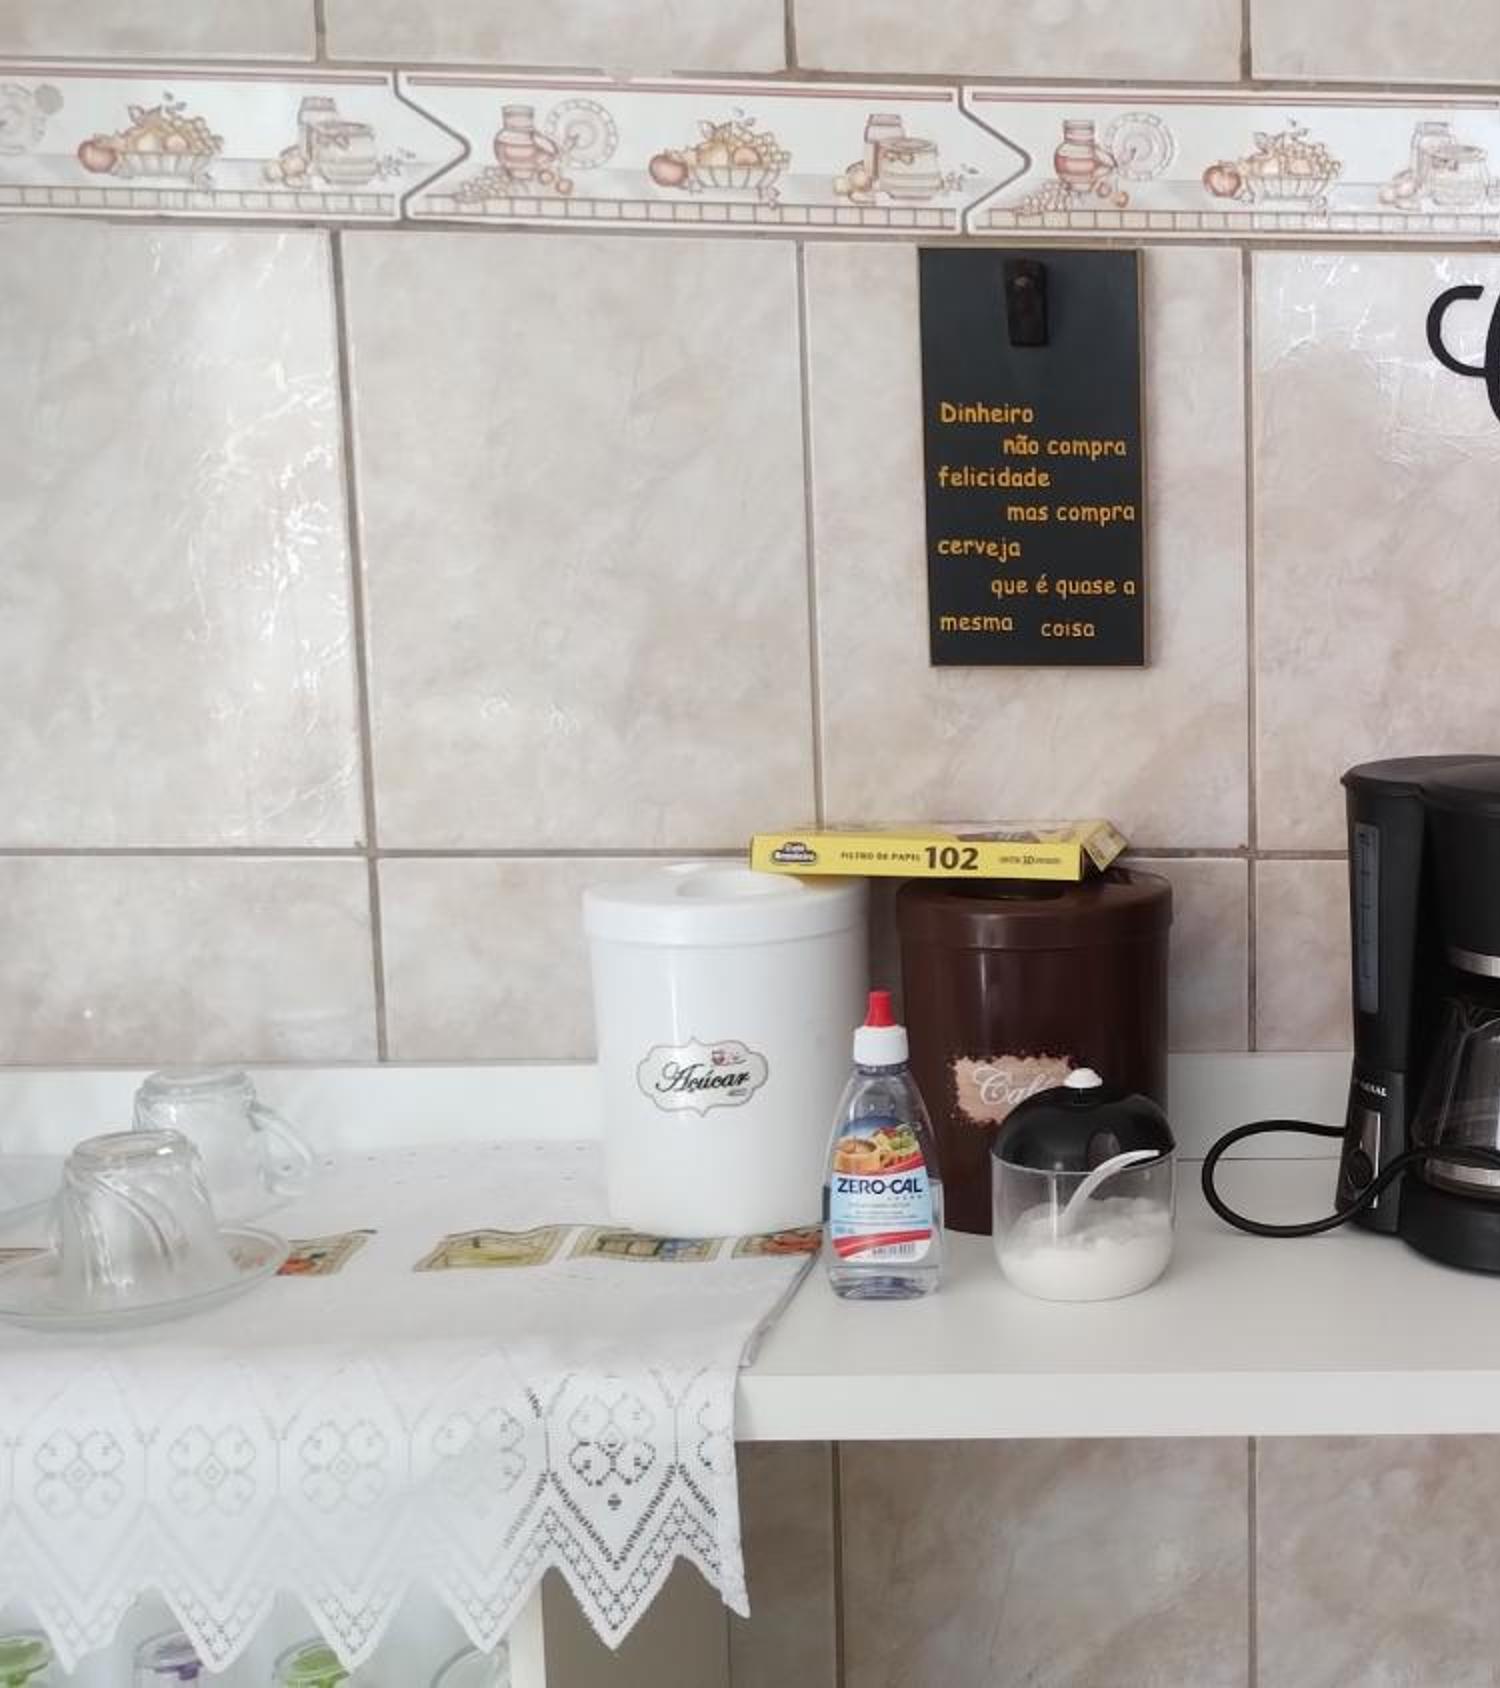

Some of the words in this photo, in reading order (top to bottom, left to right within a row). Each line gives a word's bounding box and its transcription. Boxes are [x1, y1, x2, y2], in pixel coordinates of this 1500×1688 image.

[940, 401, 1034, 424] Dinheiro
[1003, 434, 1038, 456] não
[1047, 438, 1127, 461] compra
[937, 465, 1051, 489] felicidade
[1007, 504, 1049, 522] mas
[1056, 504, 1135, 528] compra
[937, 536, 1021, 562] cerveja
[991, 576, 1029, 600] que
[1036, 574, 1049, 595] é
[1055, 577, 1117, 600] quase
[1123, 579, 1136, 596] a
[939, 614, 1013, 632] mesma
[1040, 618, 1096, 639] coisa
[925, 846, 979, 871] 102
[837, 1177, 924, 1195] ZERO-CAL
